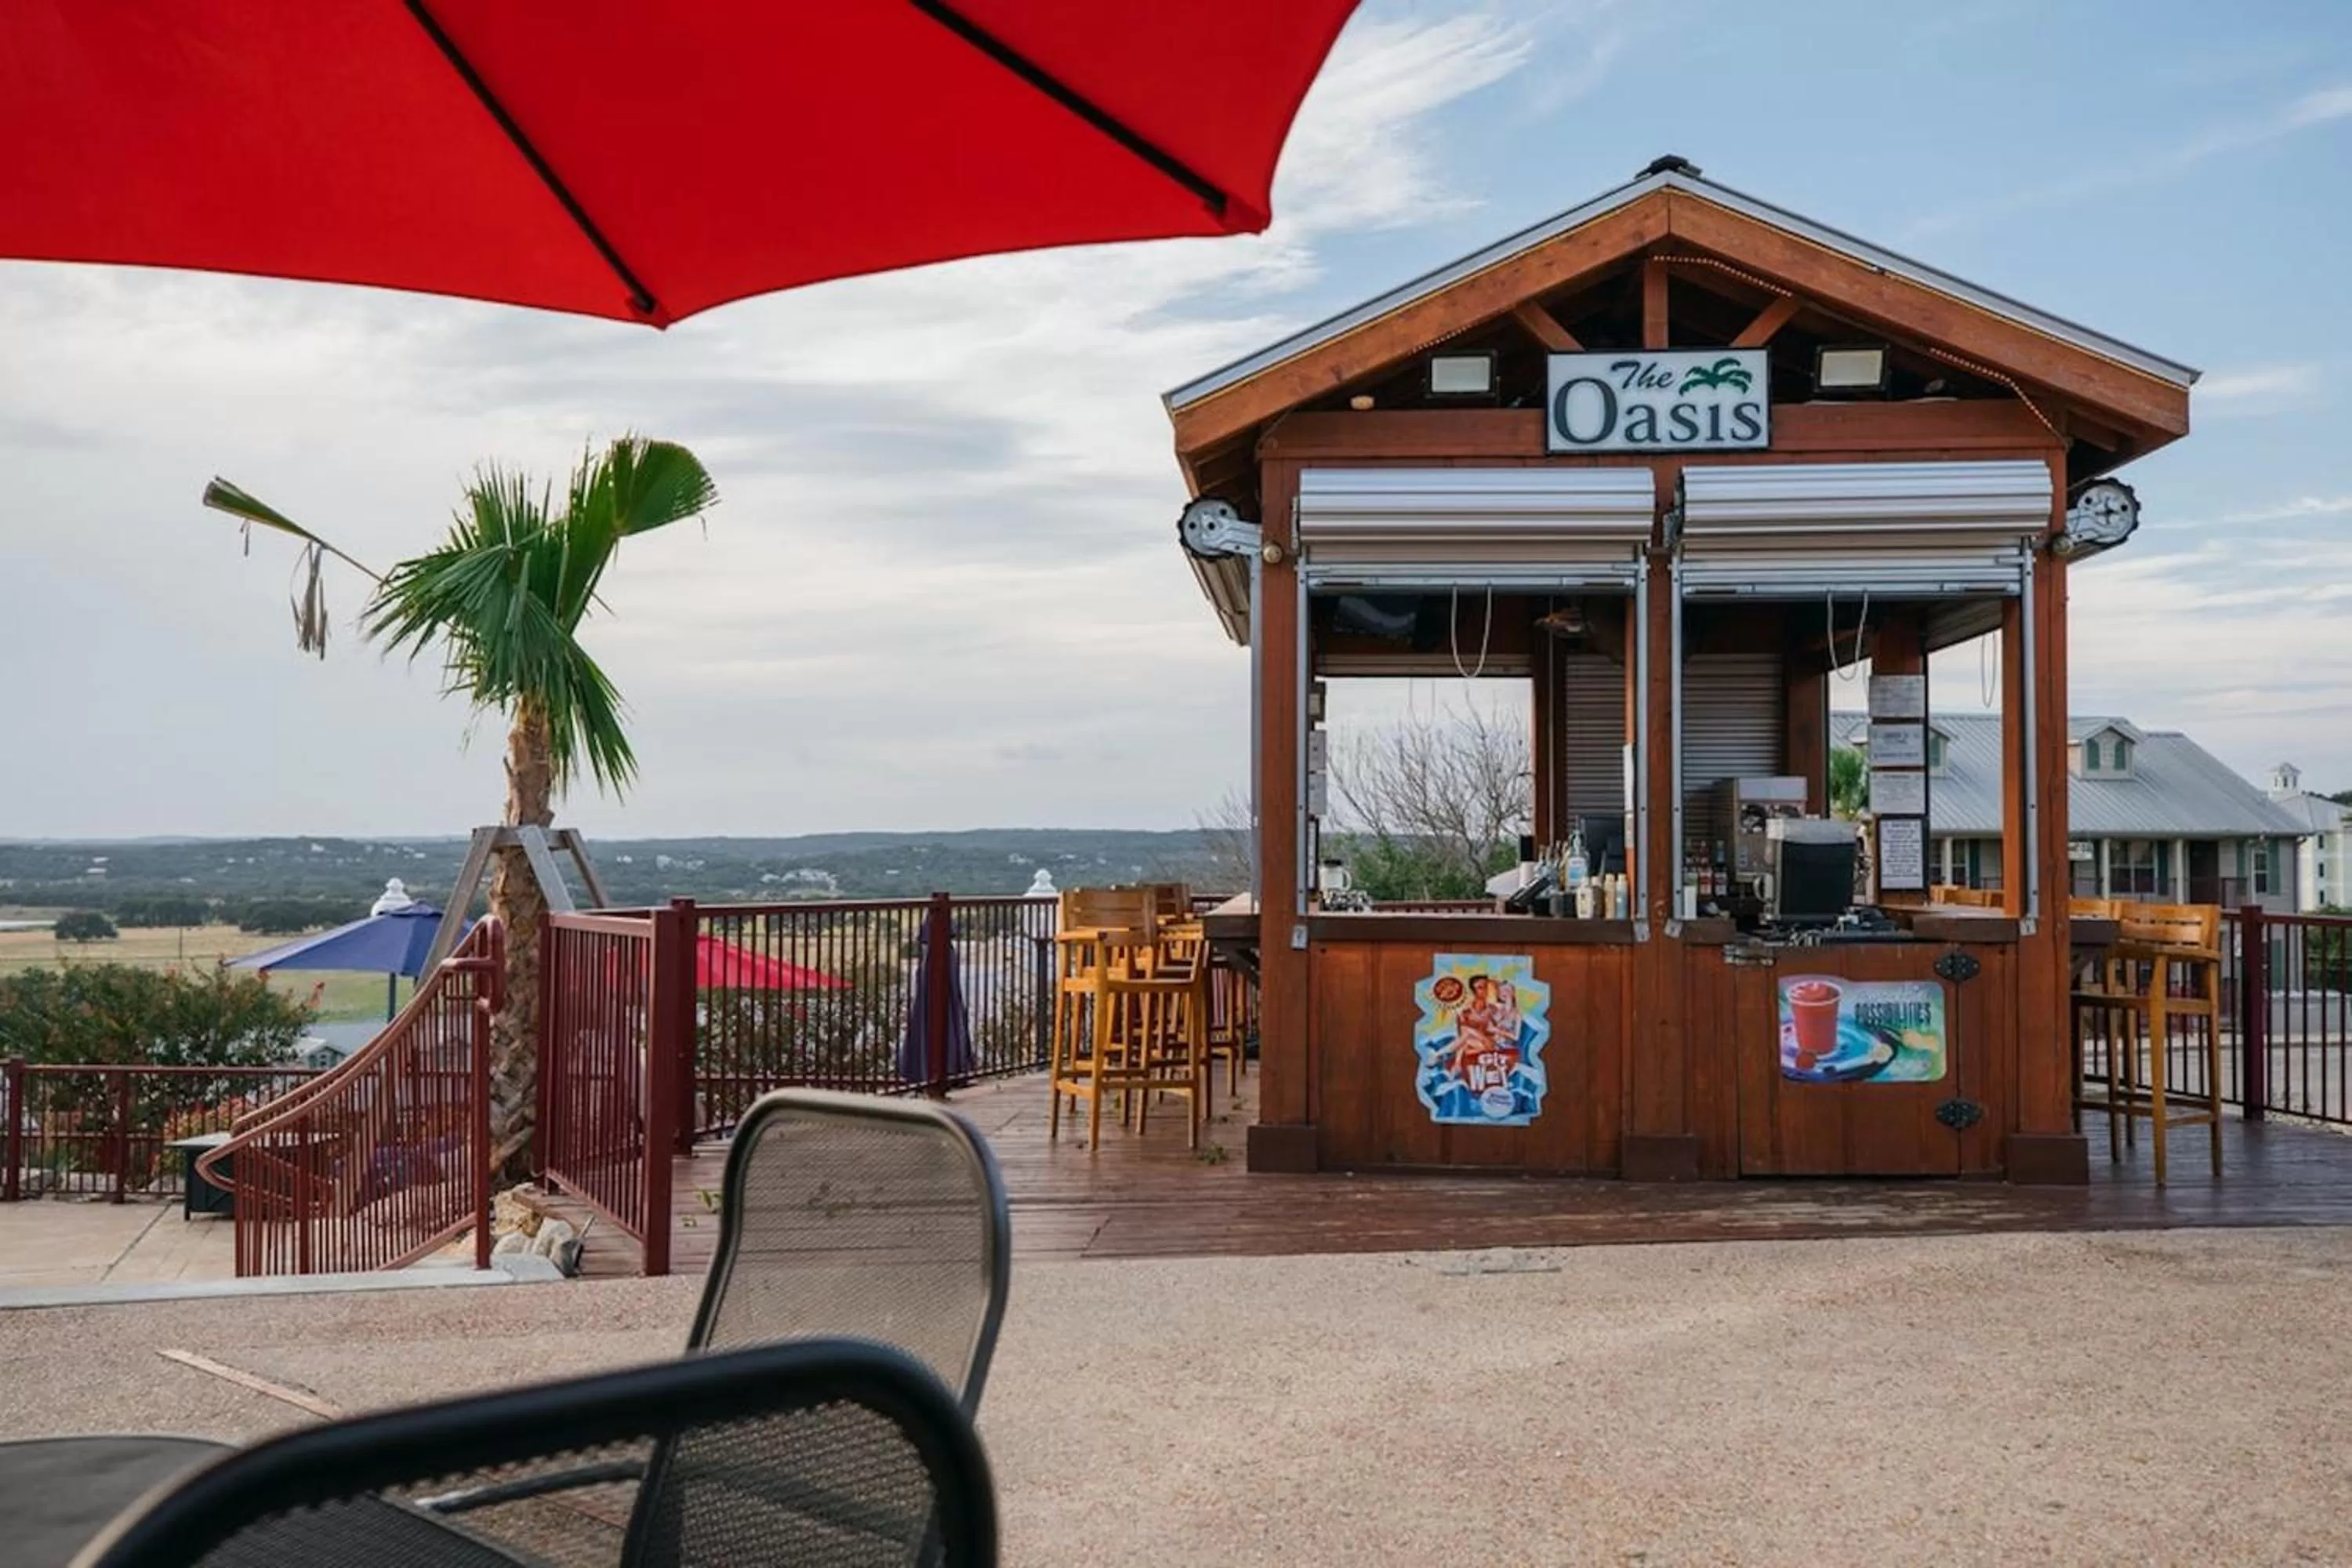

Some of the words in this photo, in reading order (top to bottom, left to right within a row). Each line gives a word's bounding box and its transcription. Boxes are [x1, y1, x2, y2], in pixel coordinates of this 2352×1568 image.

[1610, 358, 1675, 390] The
[1553, 376, 1762, 445] Oasis
[1855, 1003, 1931, 1026] POSSIBILITIES
